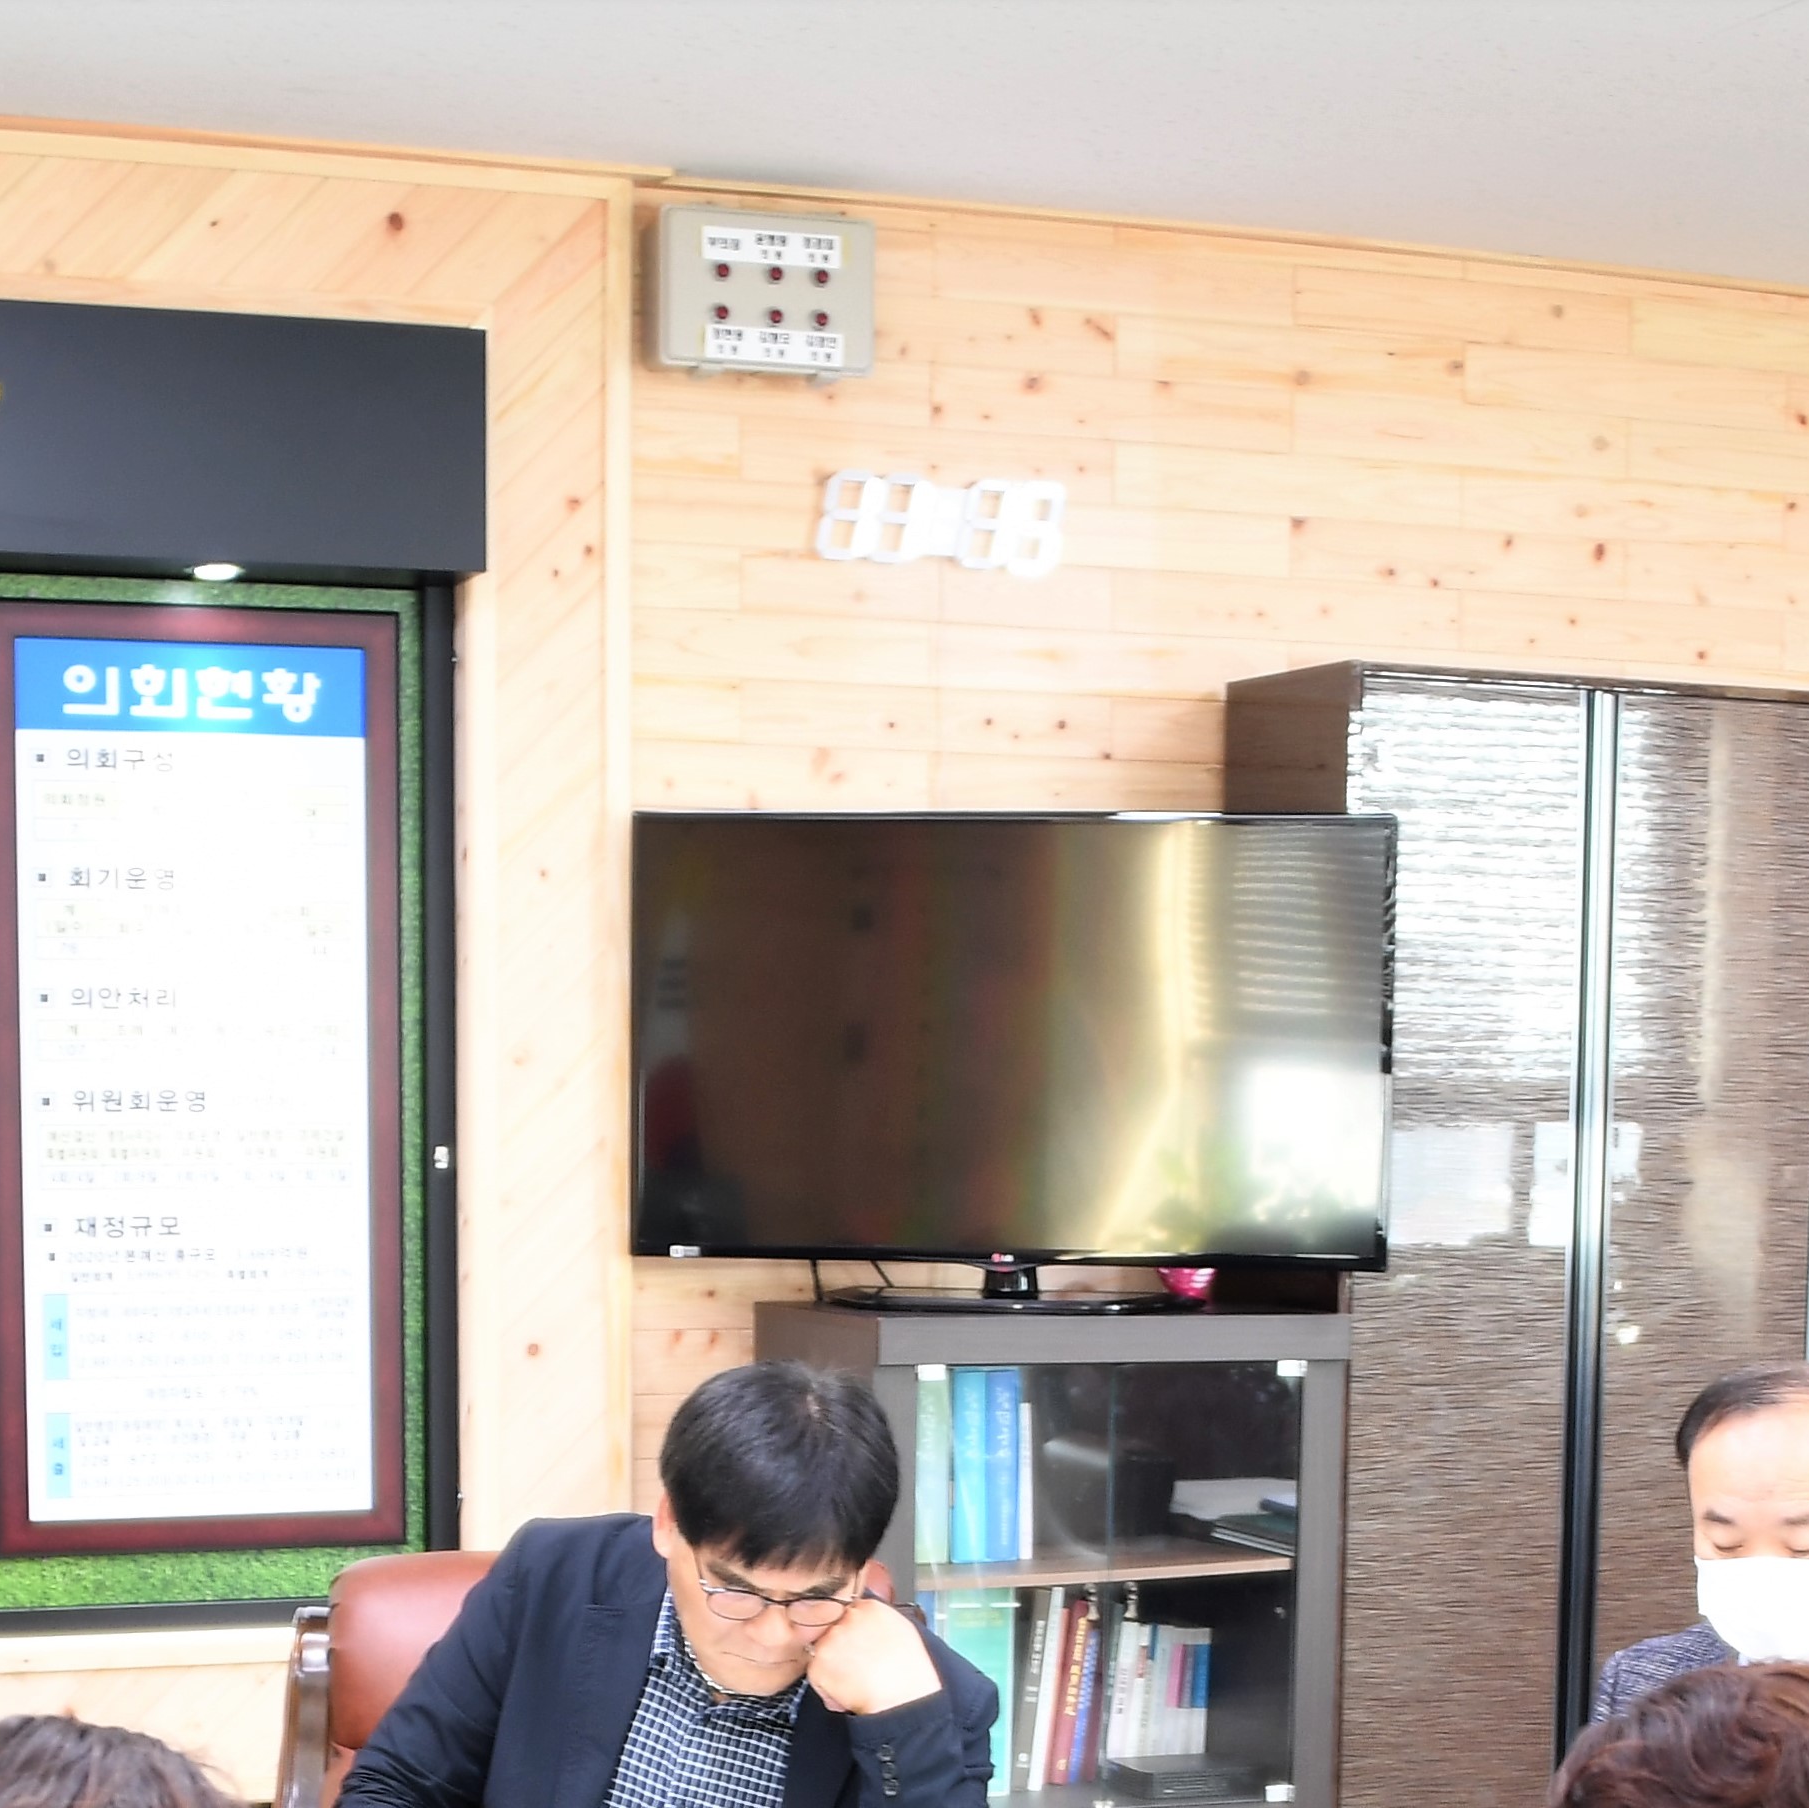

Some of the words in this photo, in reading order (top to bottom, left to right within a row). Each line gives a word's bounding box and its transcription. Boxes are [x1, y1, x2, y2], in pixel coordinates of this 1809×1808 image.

[62, 664, 322, 723] 의회현황
[66, 748, 175, 773] 의회구성
[68, 867, 175, 890] 회기운영
[70, 988, 177, 1010] 의안처리
[73, 1089, 207, 1113] 위원회운영
[74, 1216, 182, 1239] 재정규모
